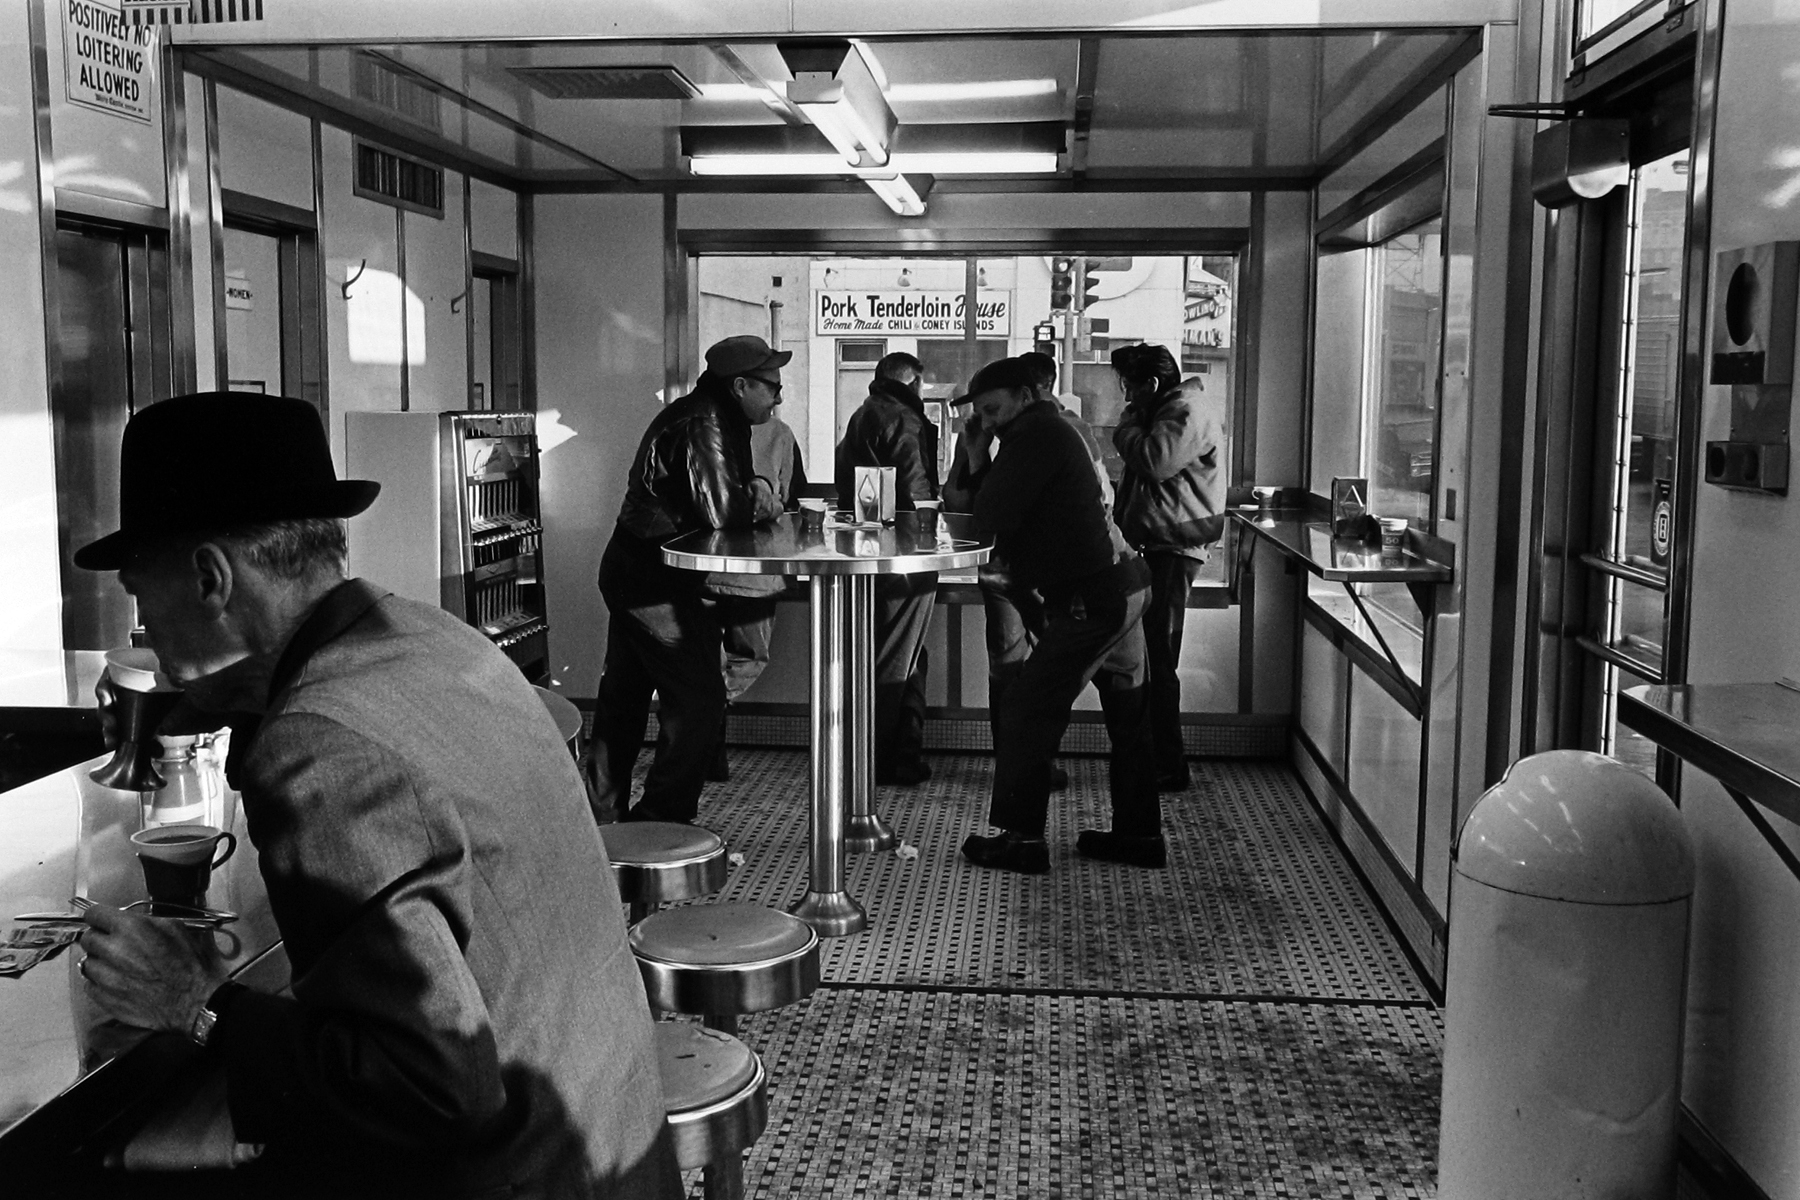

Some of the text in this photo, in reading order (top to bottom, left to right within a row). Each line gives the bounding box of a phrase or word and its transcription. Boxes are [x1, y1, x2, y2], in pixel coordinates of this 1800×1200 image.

[69, 0, 151, 47] POSITIVELY NO
[76, 32, 143, 74] LOITERING
[80, 63, 140, 101] ALLOWED
[822, 294, 1006, 318] Pork Tenderloin Huse
[823, 318, 852, 330] Home
[854, 318, 884, 330] Made
[888, 319, 912, 330] CHILI
[921, 319, 950, 330] CONEY
[953, 319, 995, 330] ISLNDS
